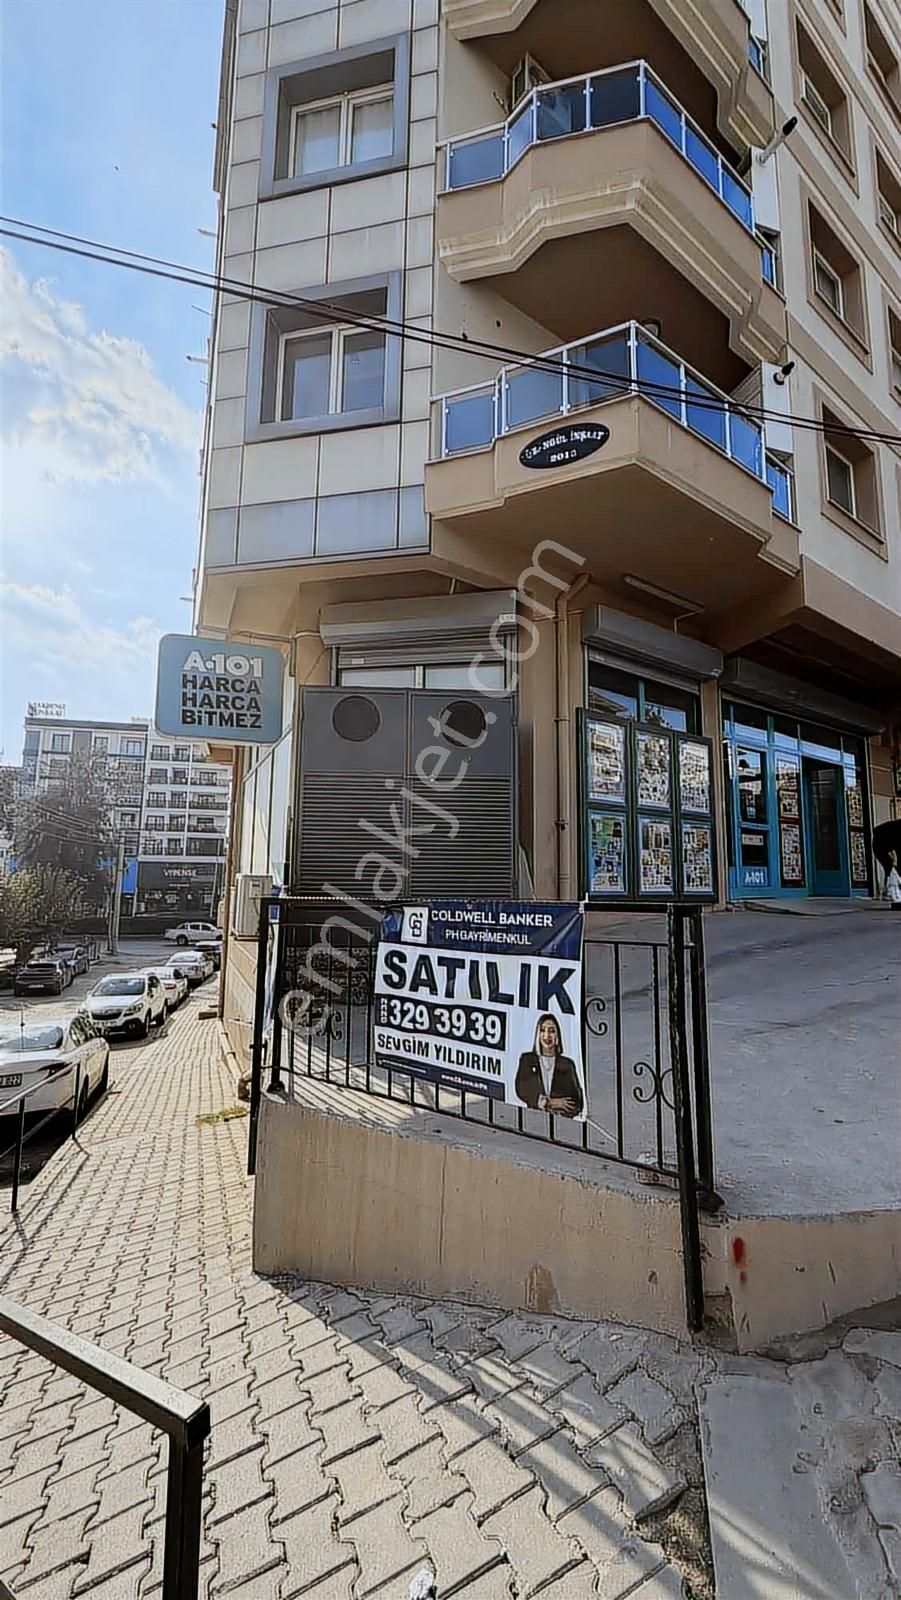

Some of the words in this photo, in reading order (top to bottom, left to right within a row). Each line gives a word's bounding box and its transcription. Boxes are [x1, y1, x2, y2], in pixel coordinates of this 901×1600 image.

[182, 673, 261, 695] HARCA
[182, 691, 261, 712] HARCA
[431, 909, 496, 924] COLDWELL
[499, 912, 554, 927] BANKER
[382, 949, 576, 1016] SATILIK
[390, 998, 430, 1030] 329
[377, 1033, 430, 1058] SEVGİM
[434, 1044, 502, 1076] YILDIRIM
